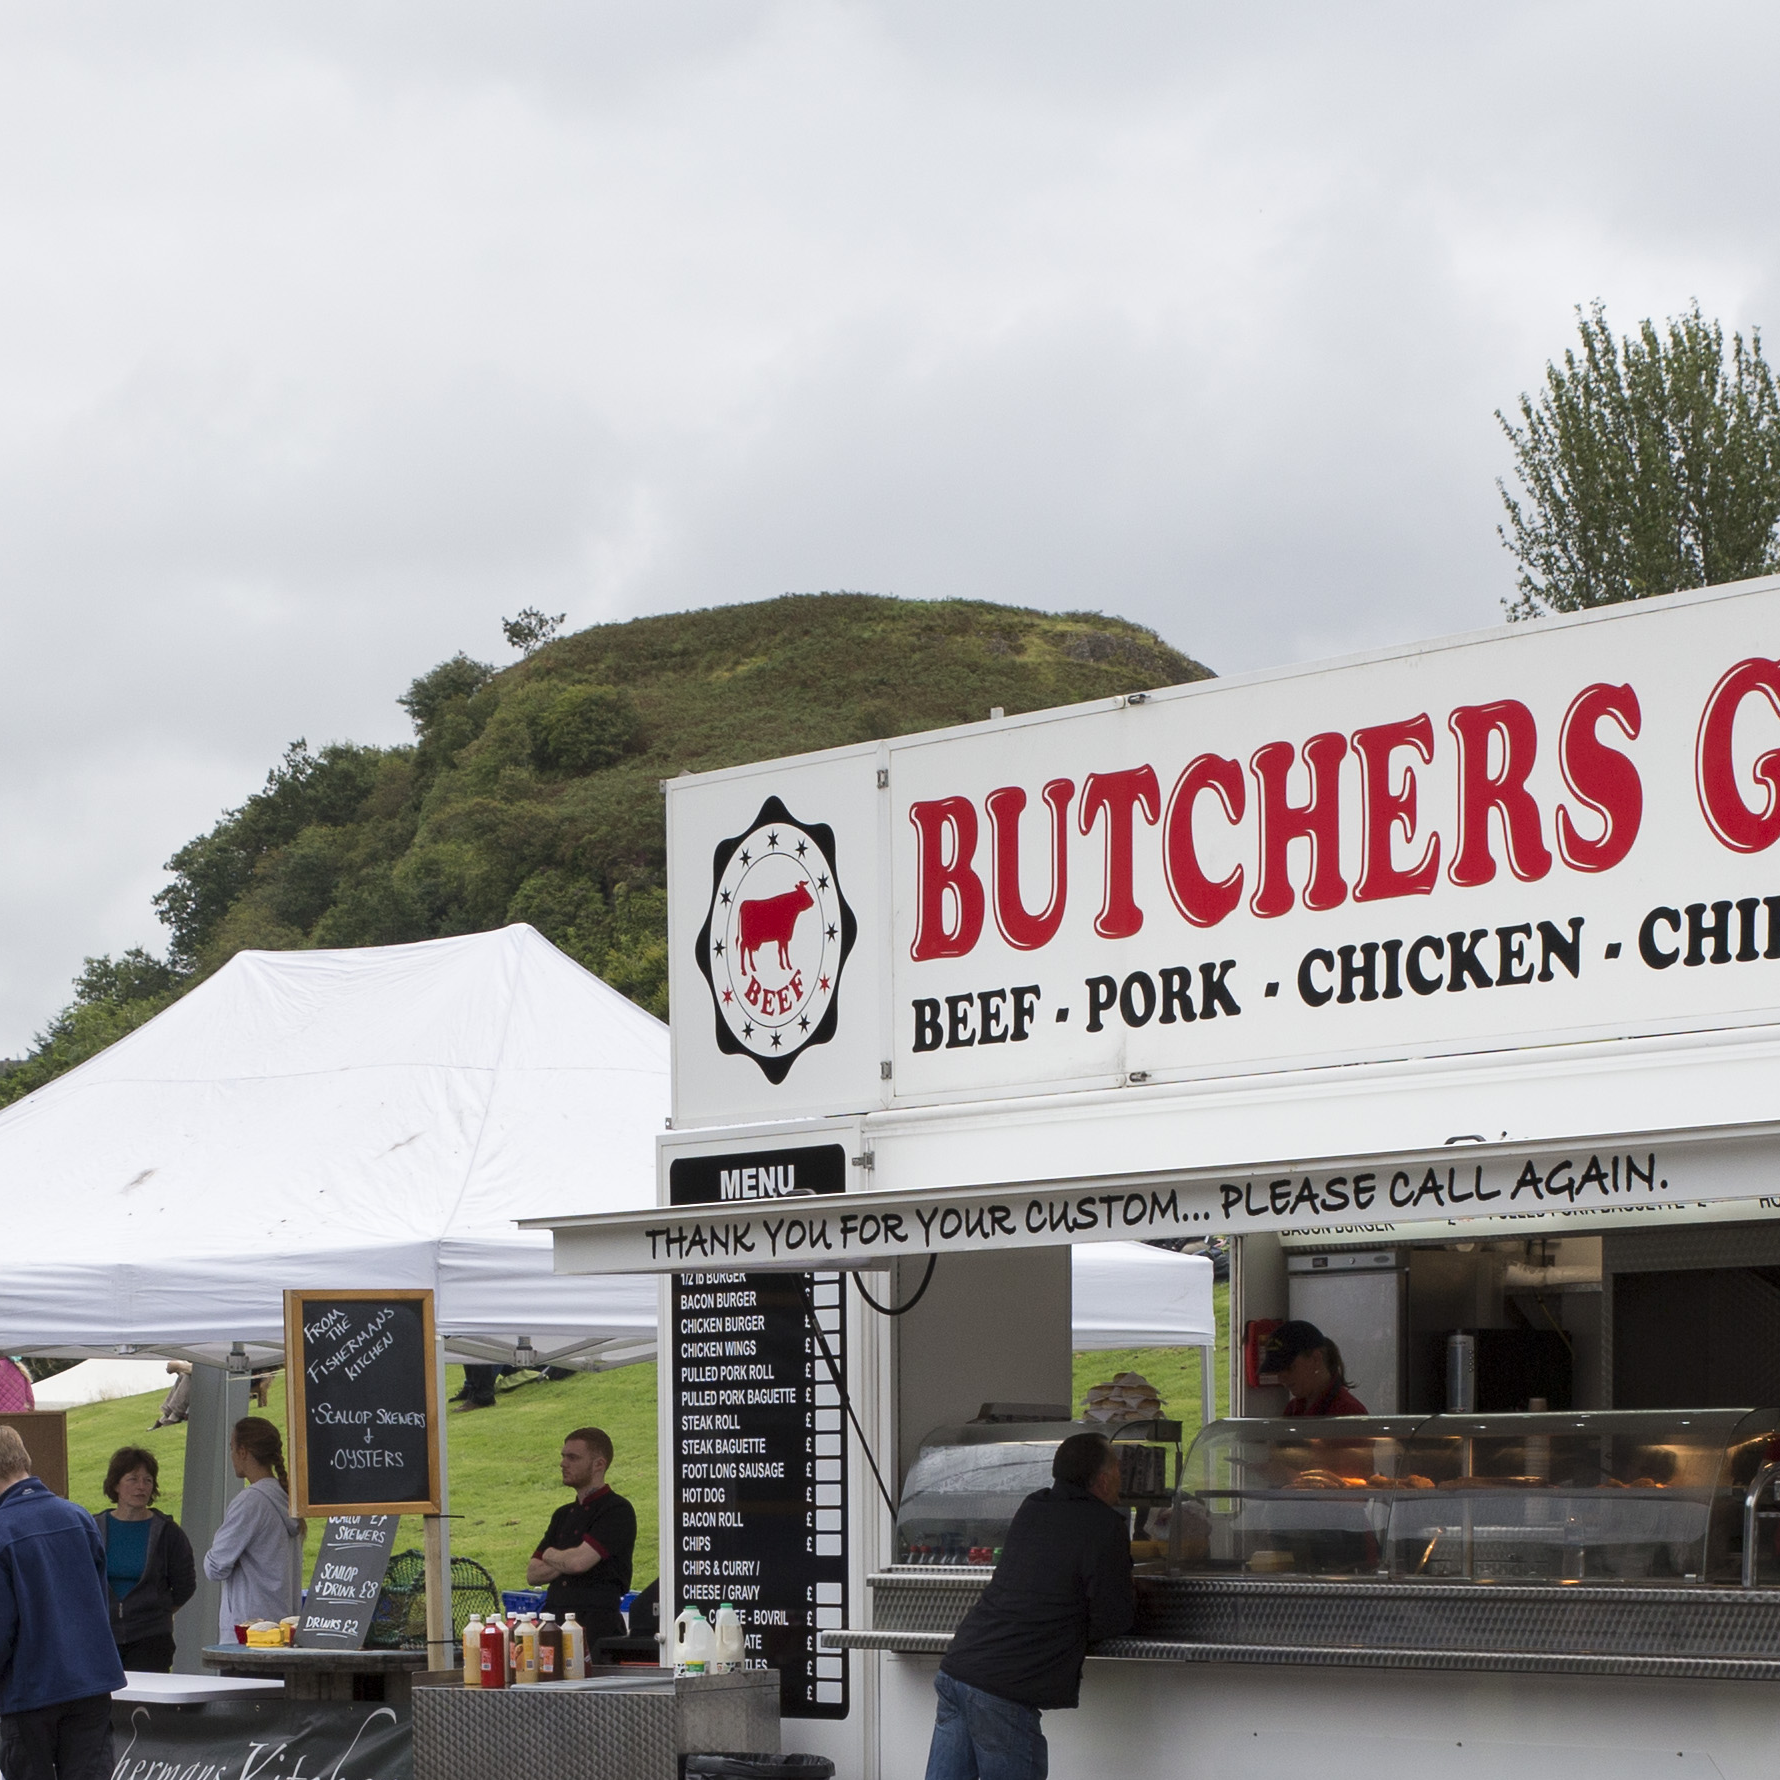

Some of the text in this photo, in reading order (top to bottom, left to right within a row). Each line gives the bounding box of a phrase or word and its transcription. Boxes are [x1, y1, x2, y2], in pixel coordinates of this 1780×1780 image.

[909, 684, 1643, 962] BUTCHERS
[744, 969, 804, 1017] BEEF
[912, 985, 1041, 1054] BEEF
[1086, 960, 1241, 1033] PORK
[1298, 916, 1585, 1008] CHICKEN
[720, 1165, 794, 1200] MENU
[645, 1222, 755, 1259] THANK
[763, 1218, 832, 1257] YOU
[840, 1214, 908, 1249] FOR
[915, 1206, 1013, 1251] YOUR
[1219, 1172, 1376, 1219] PLEASE
[1389, 1164, 1501, 1208] CALL
[1511, 1153, 1668, 1202] AGAIN.
[680, 1291, 756, 1310] BACON BURGER
[304, 1309, 345, 1344] FROM
[326, 1316, 351, 1340] THE
[681, 1315, 765, 1334] CHICKEN BURGER
[307, 1307, 395, 1384] FISHERMANS
[681, 1342, 722, 1358] CHICKEN
[725, 1340, 756, 1356] WINGS
[345, 1331, 393, 1381] KITCHEN
[681, 1366, 718, 1382] PULLED
[720, 1365, 747, 1381] PORK
[749, 1364, 774, 1380] ROLL
[681, 1391, 717, 1406] PULLED
[719, 1389, 745, 1405] PORK
[747, 1388, 796, 1404] BAGUETTE
[376, 1408, 426, 1428] SKEWERS
[682, 1415, 713, 1430] STEAK
[716, 1413, 740, 1429] ROLL
[682, 1439, 713, 1454] STEAK
[716, 1438, 766, 1453] BAGUETTE
[682, 1464, 708, 1479] FOOT
[710, 1463, 736, 1478] LONG
[739, 1462, 784, 1478] SAUSAGE
[683, 1488, 702, 1502] HOT
[704, 1487, 725, 1502] DOG
[683, 1512, 743, 1527] BACON ROLL
[335, 1526, 386, 1543] SKEWERS
[683, 1536, 710, 1551] CHIPS
[321, 1562, 358, 1582] SCALLOP
[683, 1560, 754, 1575] CHIPS & CURRY
[359, 1580, 378, 1598] £8
[683, 1585, 760, 1600] CHEESE GRAVY
[306, 1615, 359, 1634] DRINKS £2
[754, 1610, 788, 1625] BOVRIL
